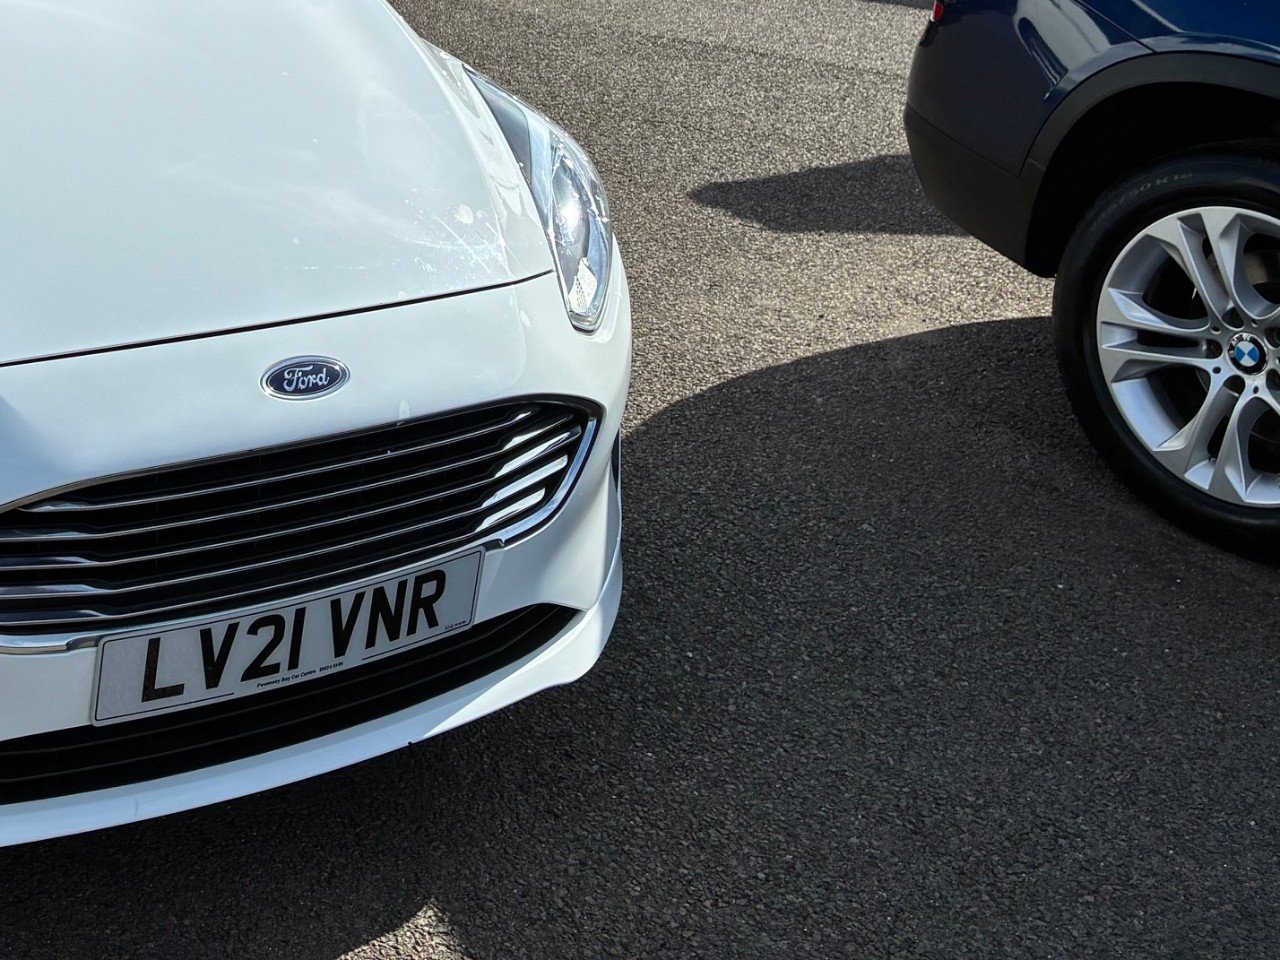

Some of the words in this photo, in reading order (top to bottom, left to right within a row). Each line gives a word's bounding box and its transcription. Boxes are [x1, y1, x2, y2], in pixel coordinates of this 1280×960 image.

[283, 364, 330, 392] Ford
[141, 606, 307, 703] LV21
[329, 569, 447, 659] VNR
